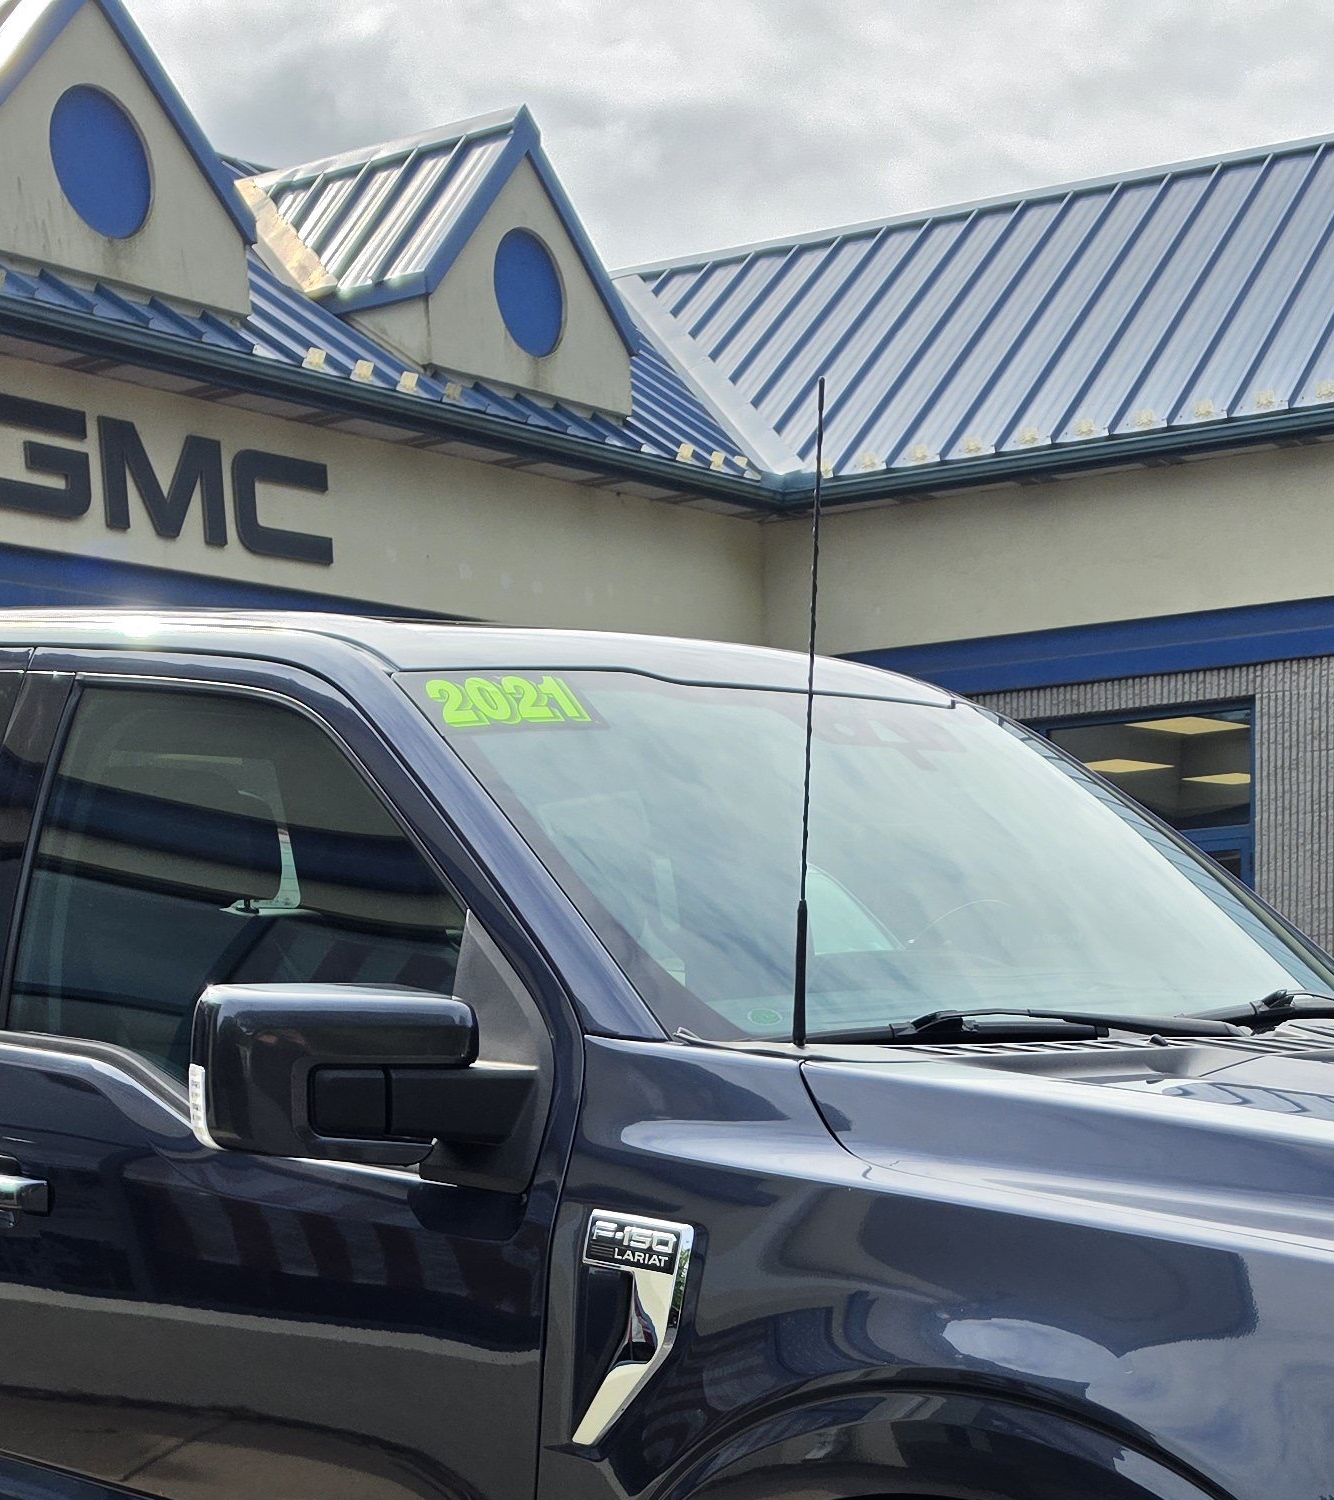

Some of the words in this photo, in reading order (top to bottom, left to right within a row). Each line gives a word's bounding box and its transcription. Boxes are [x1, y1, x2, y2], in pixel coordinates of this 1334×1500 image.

[425, 675, 592, 727] 2021
[592, 1221, 677, 1253] F-150
[614, 1248, 668, 1267] LARIAT
